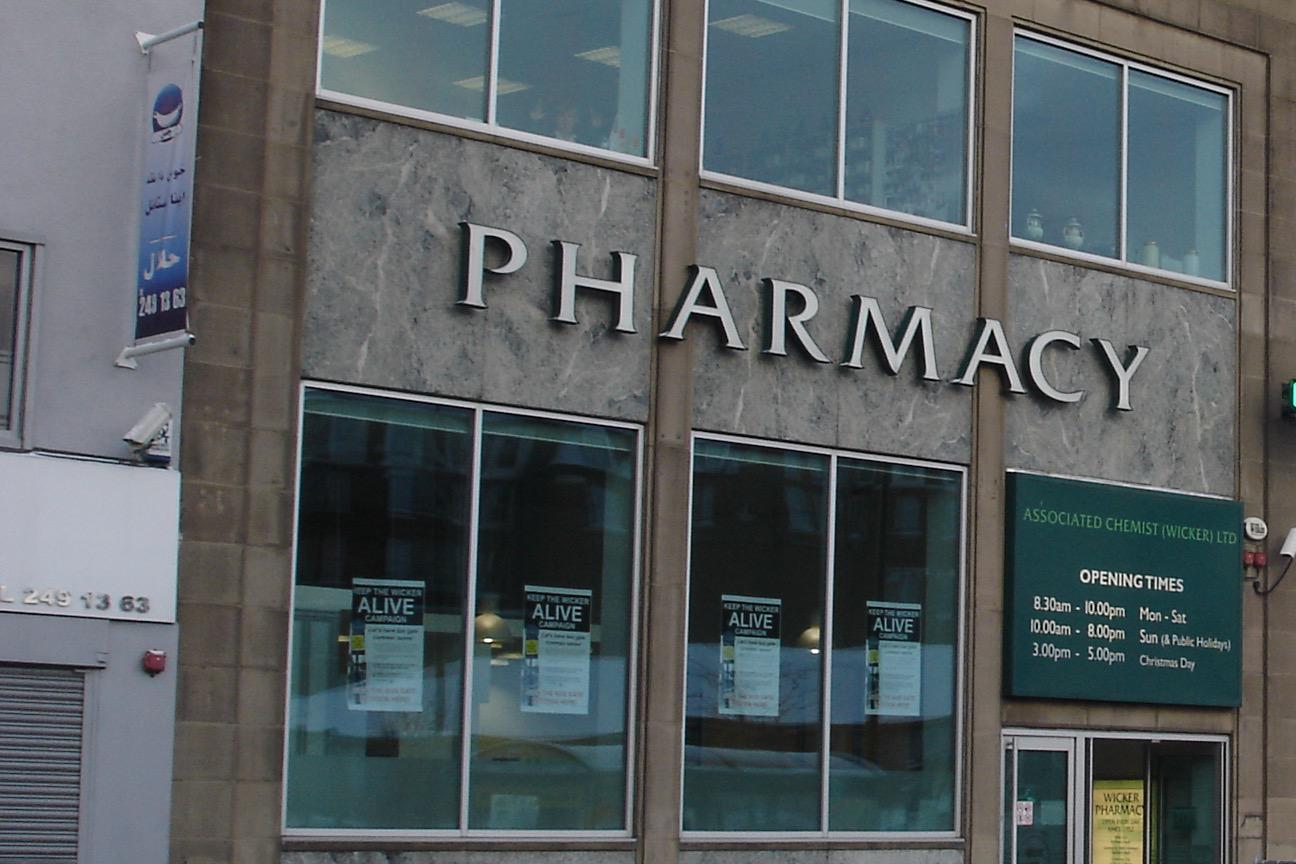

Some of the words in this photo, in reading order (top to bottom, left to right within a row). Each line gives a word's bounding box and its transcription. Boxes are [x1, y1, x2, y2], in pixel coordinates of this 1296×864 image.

[456, 220, 1151, 411] PHARMACY
[1023, 508, 1102, 529] ASSOCIATED
[1105, 518, 1158, 536] CHEMIST
[1162, 525, 1213, 544] (WICKER)
[1217, 531, 1236, 544] LTD
[1079, 569, 1143, 589] OPENING
[1146, 575, 1184, 592] TIMES
[23, 587, 71, 608] 249
[80, 591, 111, 611] 13
[119, 595, 151, 614] 63
[358, 596, 415, 615] ALIVE
[1033, 596, 1072, 613] 8.30am
[1084, 600, 1126, 620] 10.00pm
[1139, 607, 1162, 622] Mon
[1171, 609, 1187, 625] Sat
[532, 603, 583, 622] ALIVE
[728, 612, 773, 629] ALIVE
[873, 617, 915, 633] ALIVE
[1030, 619, 1071, 636] 10.00am
[1087, 623, 1126, 642] 8.00pm
[1139, 629, 1158, 645] Sun
[1172, 634, 1195, 648] Public
[1196, 637, 1232, 652] Holidays)
[1032, 642, 1072, 662] 3.00pm
[1087, 647, 1126, 666] 5.00pm
[1139, 655, 1178, 668] Christmas
[1180, 657, 1196, 672] Day
[1103, 792, 1140, 803] WICKER
[1095, 804, 1144, 816] PHARMAC
